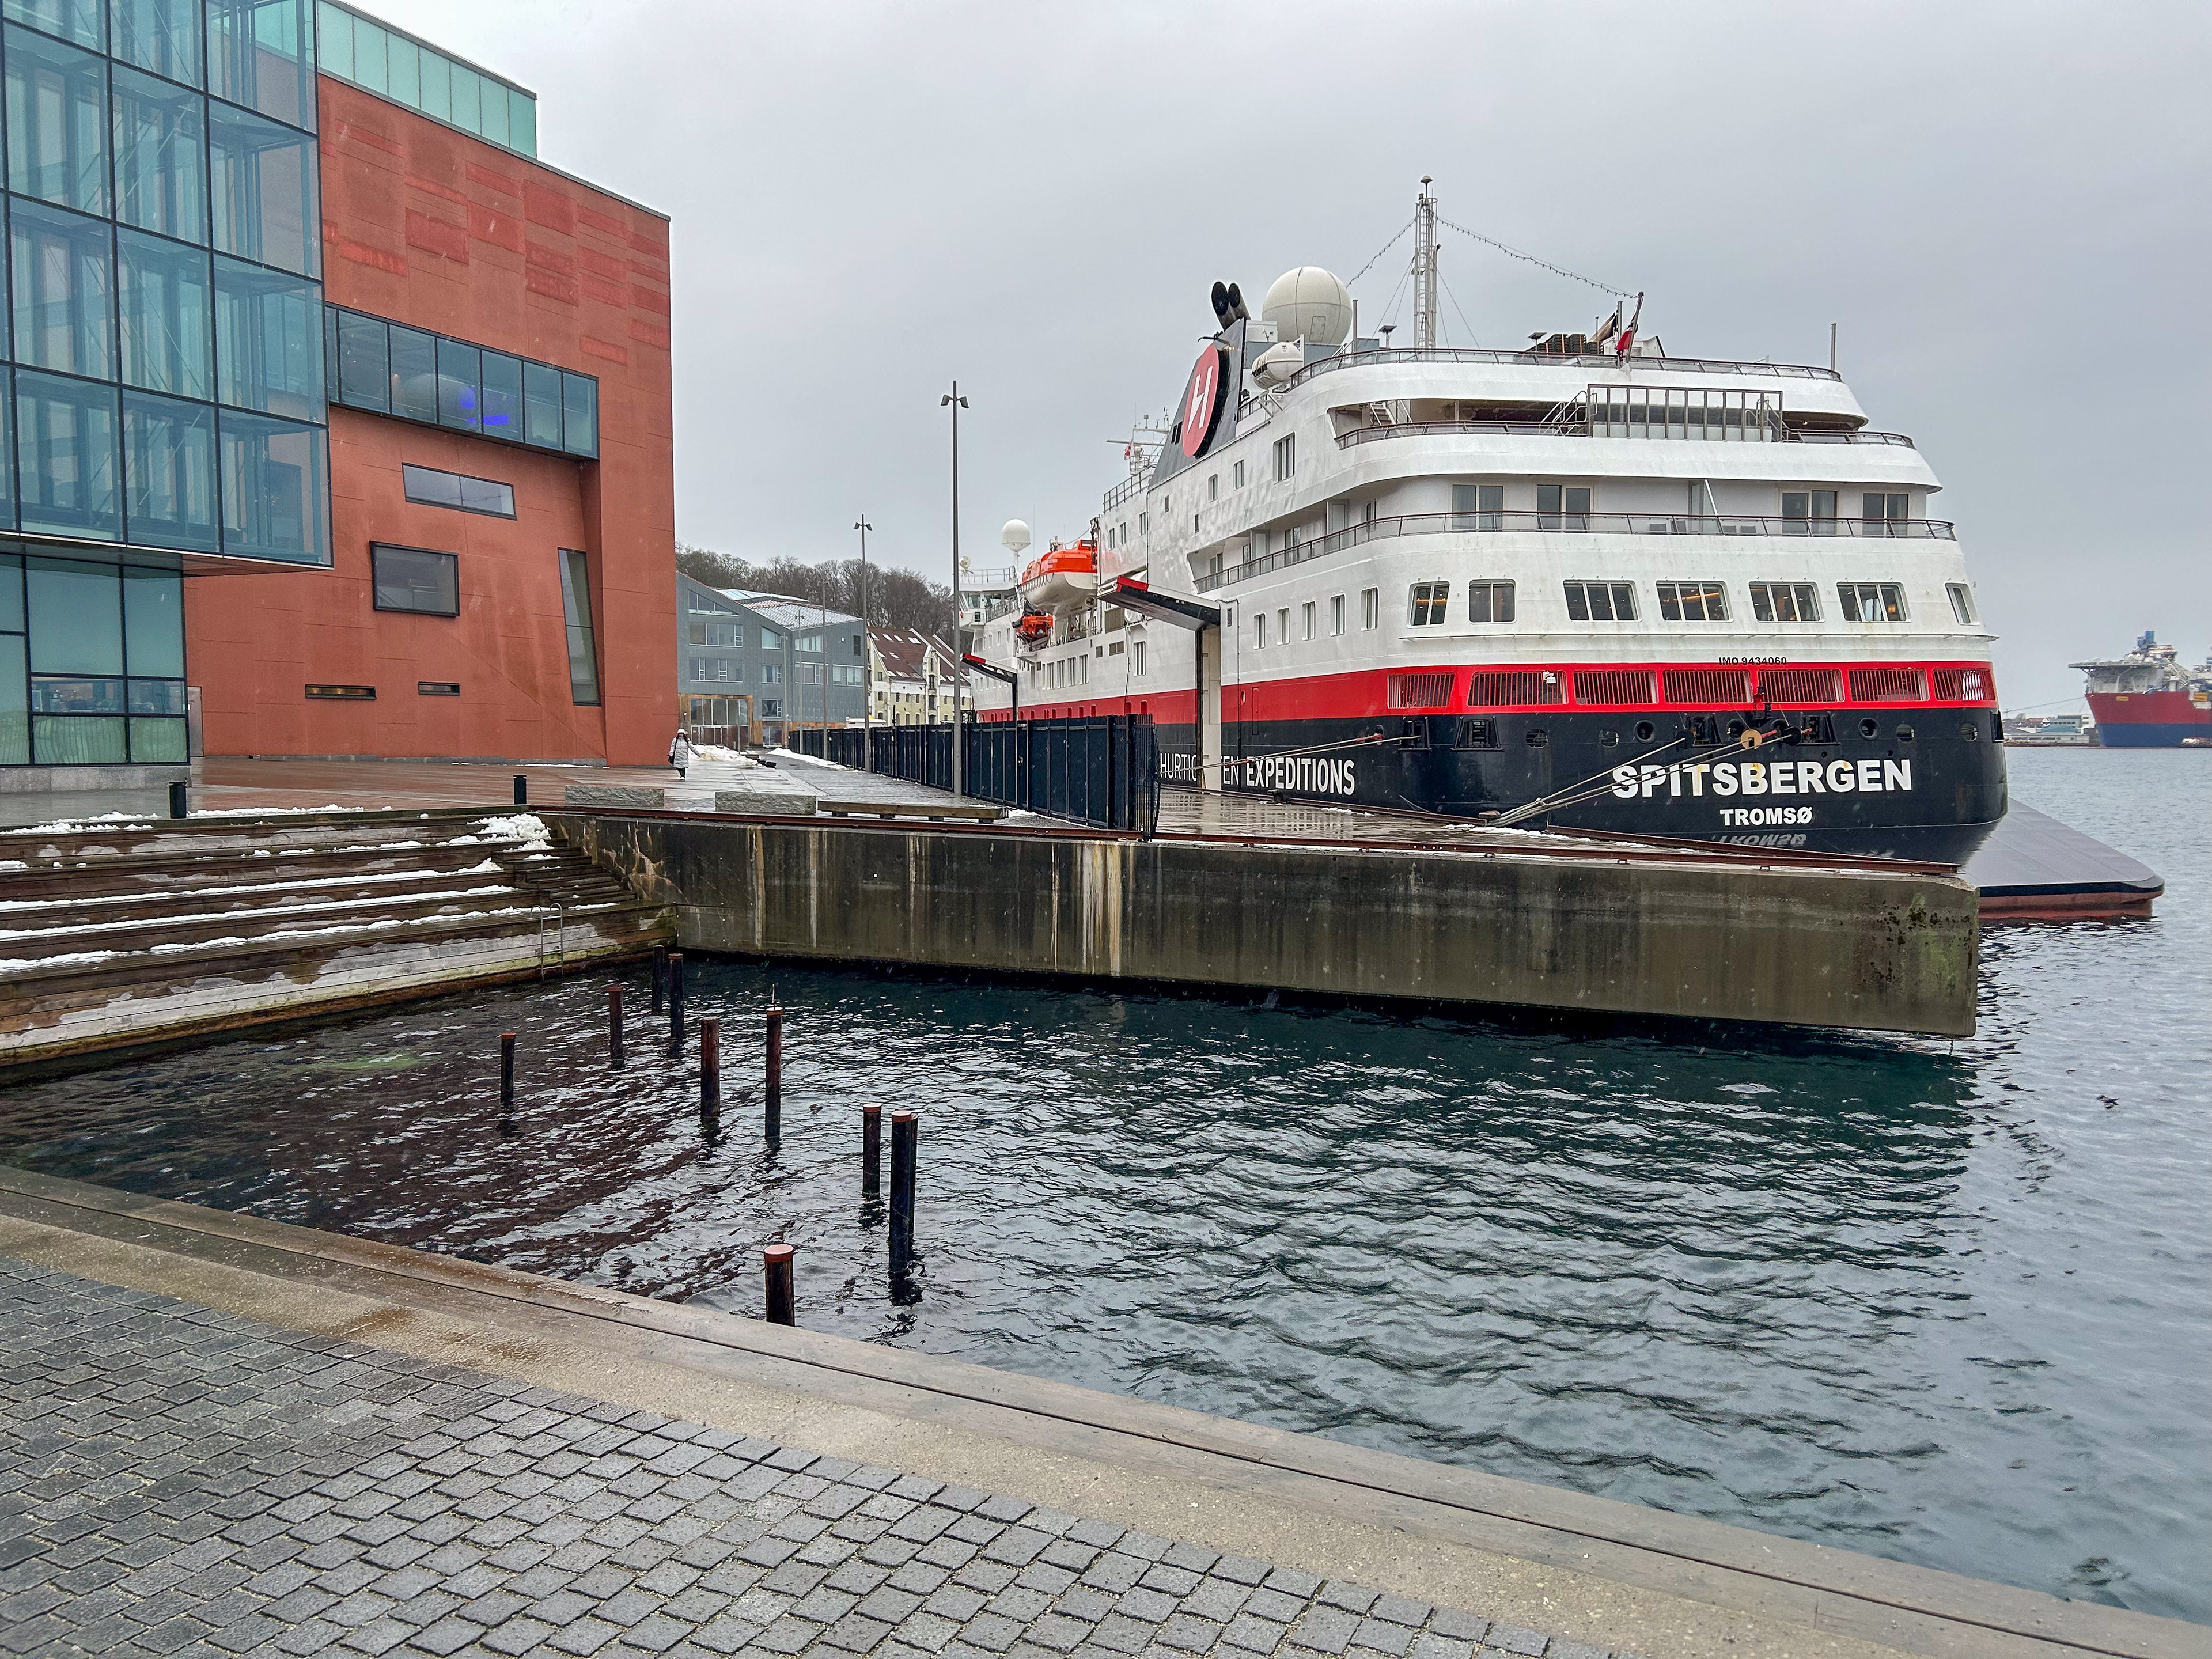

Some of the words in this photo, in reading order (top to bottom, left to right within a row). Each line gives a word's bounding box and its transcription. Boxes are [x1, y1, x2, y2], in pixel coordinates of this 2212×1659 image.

[1719, 657, 1739, 665] IMO
[1741, 657, 1787, 665] 9434060
[1247, 756, 1355, 796] EXPEDITIONS
[1612, 759, 1912, 798] SPITSBERGEN
[1719, 806, 1813, 826] TROMSØ
